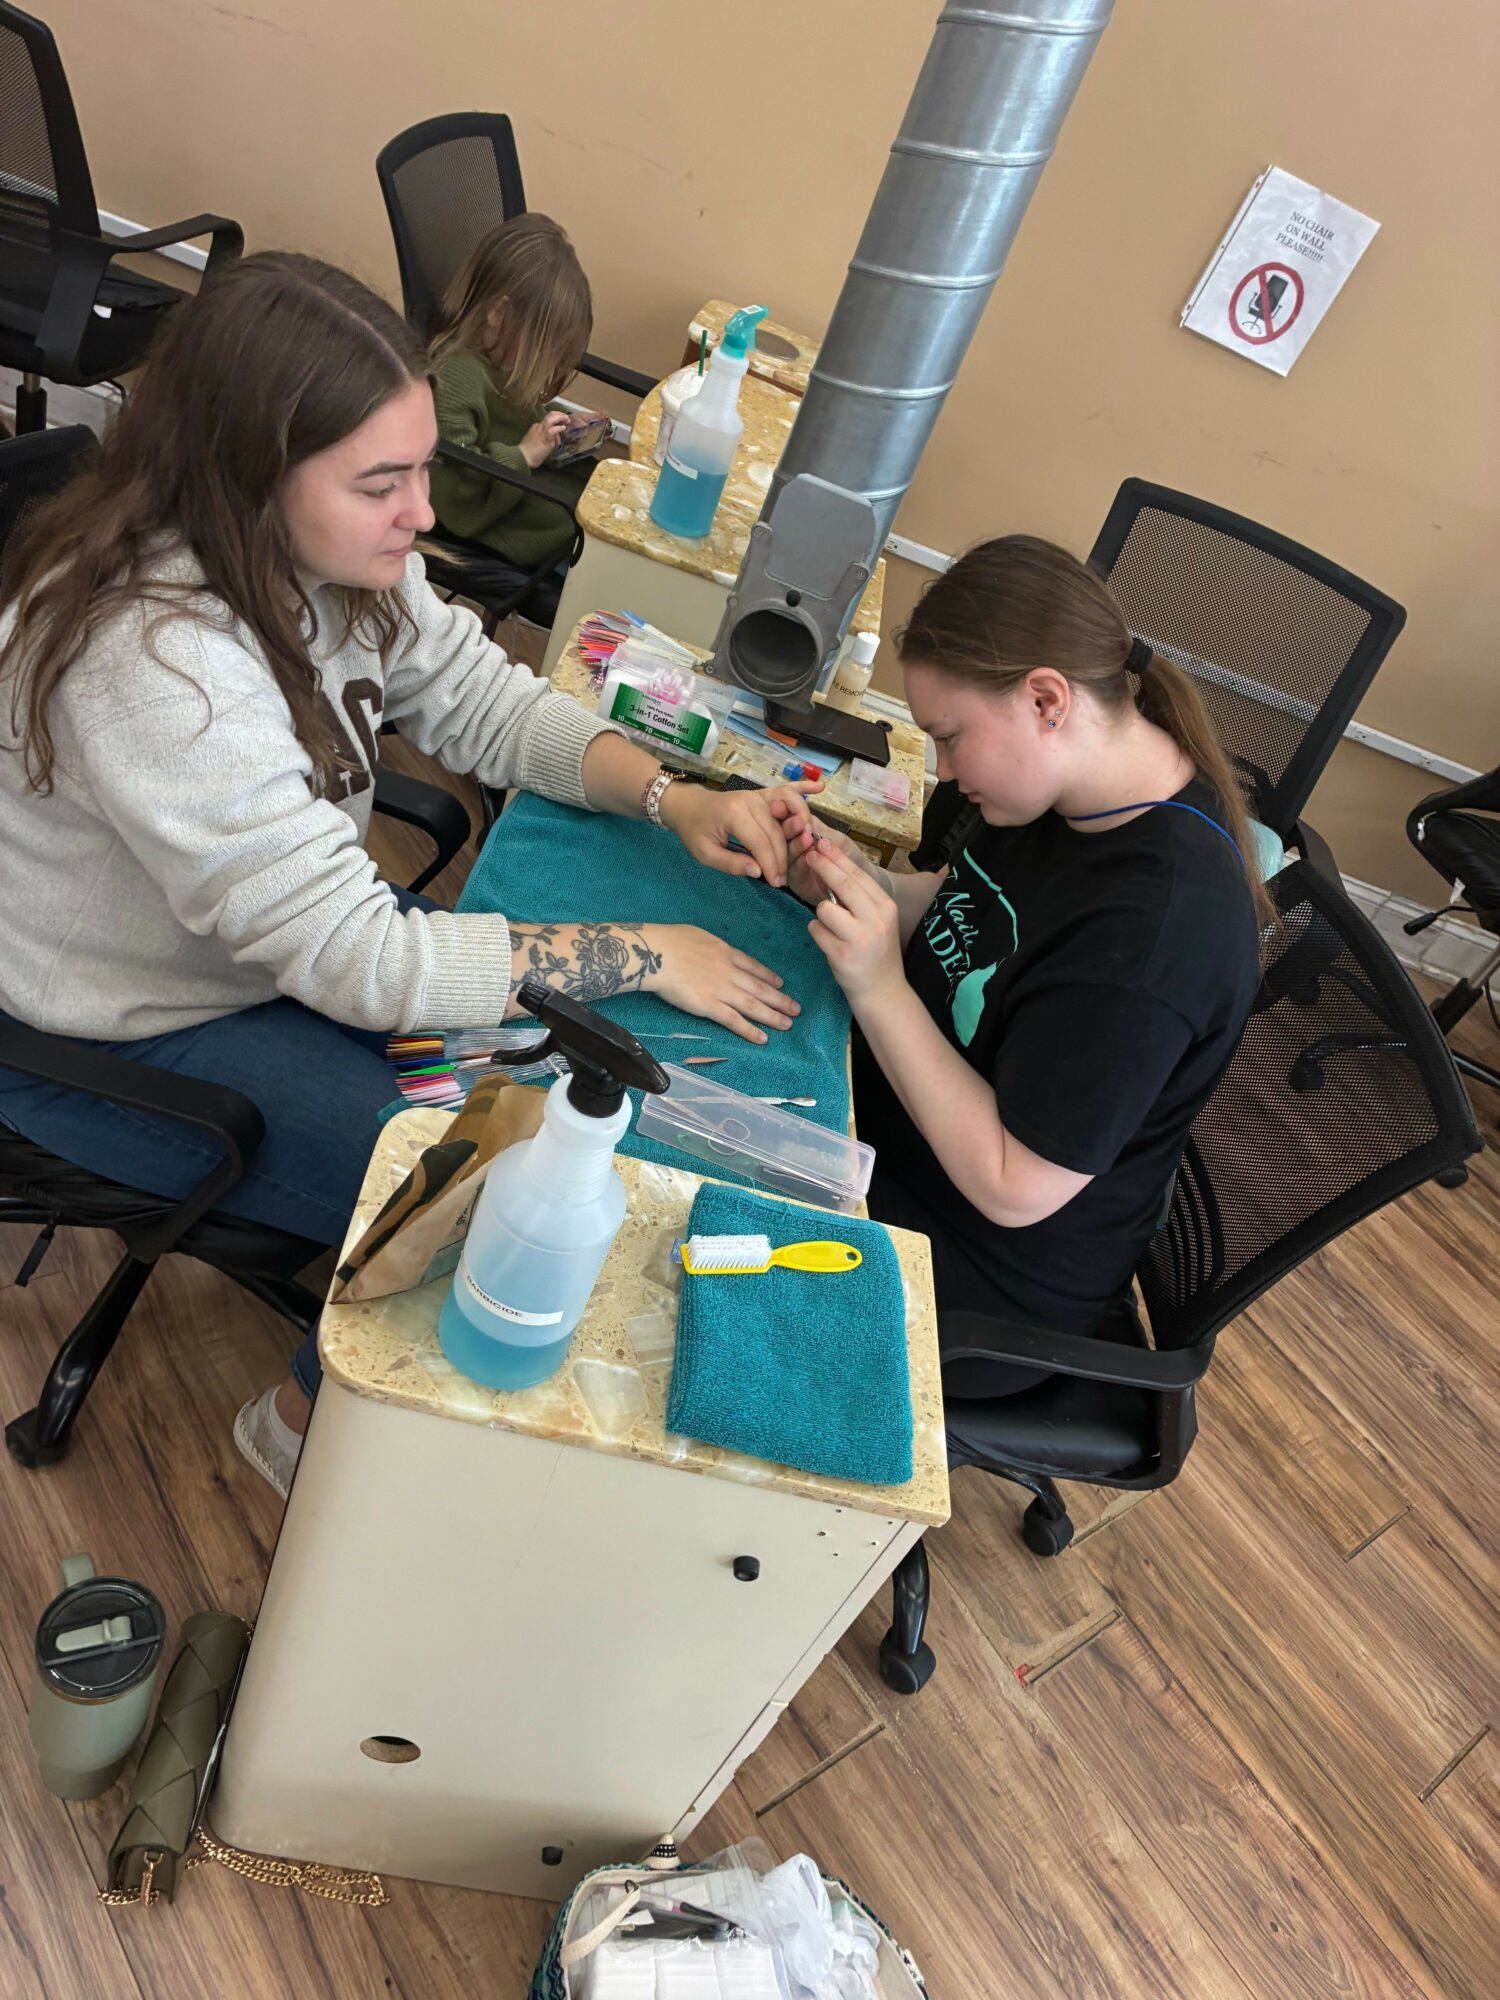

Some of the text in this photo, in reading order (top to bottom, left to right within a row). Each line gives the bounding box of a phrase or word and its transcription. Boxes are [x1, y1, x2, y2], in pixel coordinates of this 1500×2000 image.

[1285, 223, 1325, 252] ON WALL
[1290, 211, 1335, 241] NO CHAIR
[629, 704, 651, 718] 3-in-1
[653, 714, 676, 729] Cotton
[677, 724, 690, 734] Set
[645, 726, 653, 734] 70
[672, 737, 680, 745] 10
[467, 1275, 523, 1318] BARBICIDE
